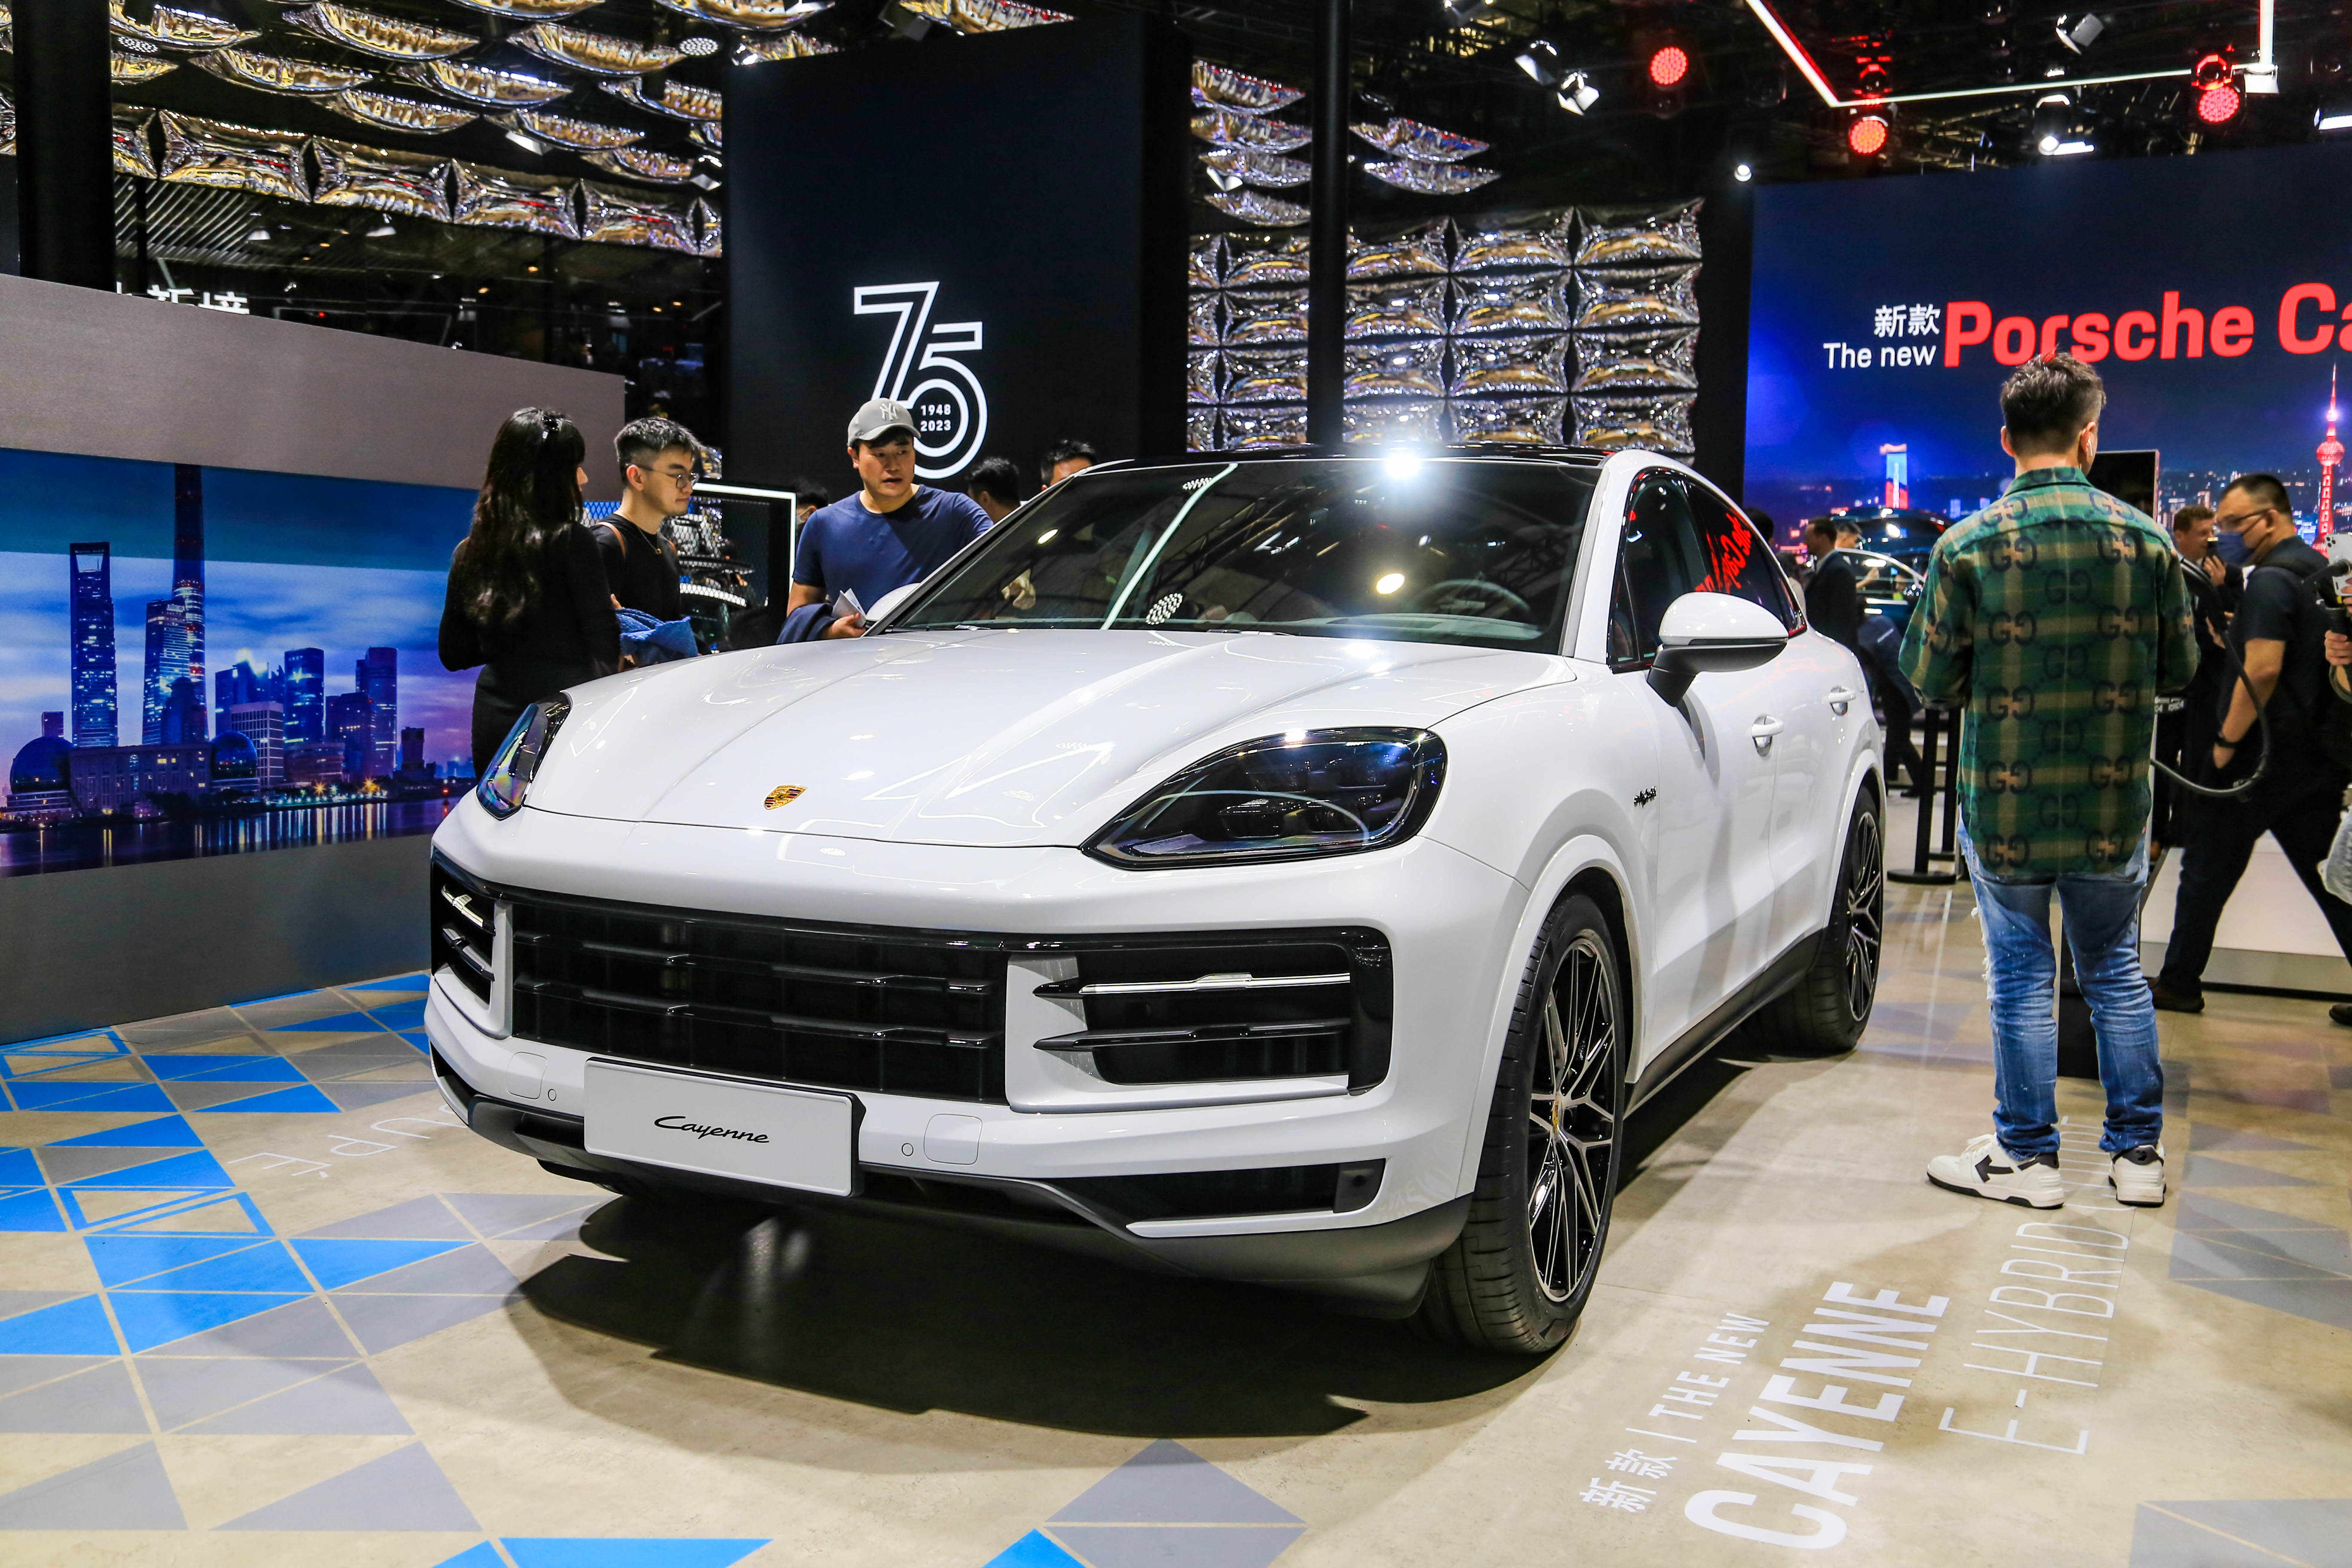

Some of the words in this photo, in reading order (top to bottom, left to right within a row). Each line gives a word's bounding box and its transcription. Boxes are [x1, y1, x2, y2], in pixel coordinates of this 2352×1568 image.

[1874, 303, 1941, 338] 新款
[1944, 291, 2254, 368] Porsche
[1823, 342, 1871, 369] The
[1881, 345, 1936, 367] new
[854, 281, 988, 479] 75
[879, 402, 899, 420] NY
[920, 420, 951, 432] 2023
[921, 404, 950, 416] 1948
[654, 1116, 770, 1143] Cayenne
[1939, 1222, 2129, 1455] E-HYBRID
[1580, 1449, 1678, 1513] 新款
[1648, 1370, 1730, 1420] THE
[1694, 1312, 1770, 1365] NEW
[1684, 1281, 1950, 1549] CAYENNE
